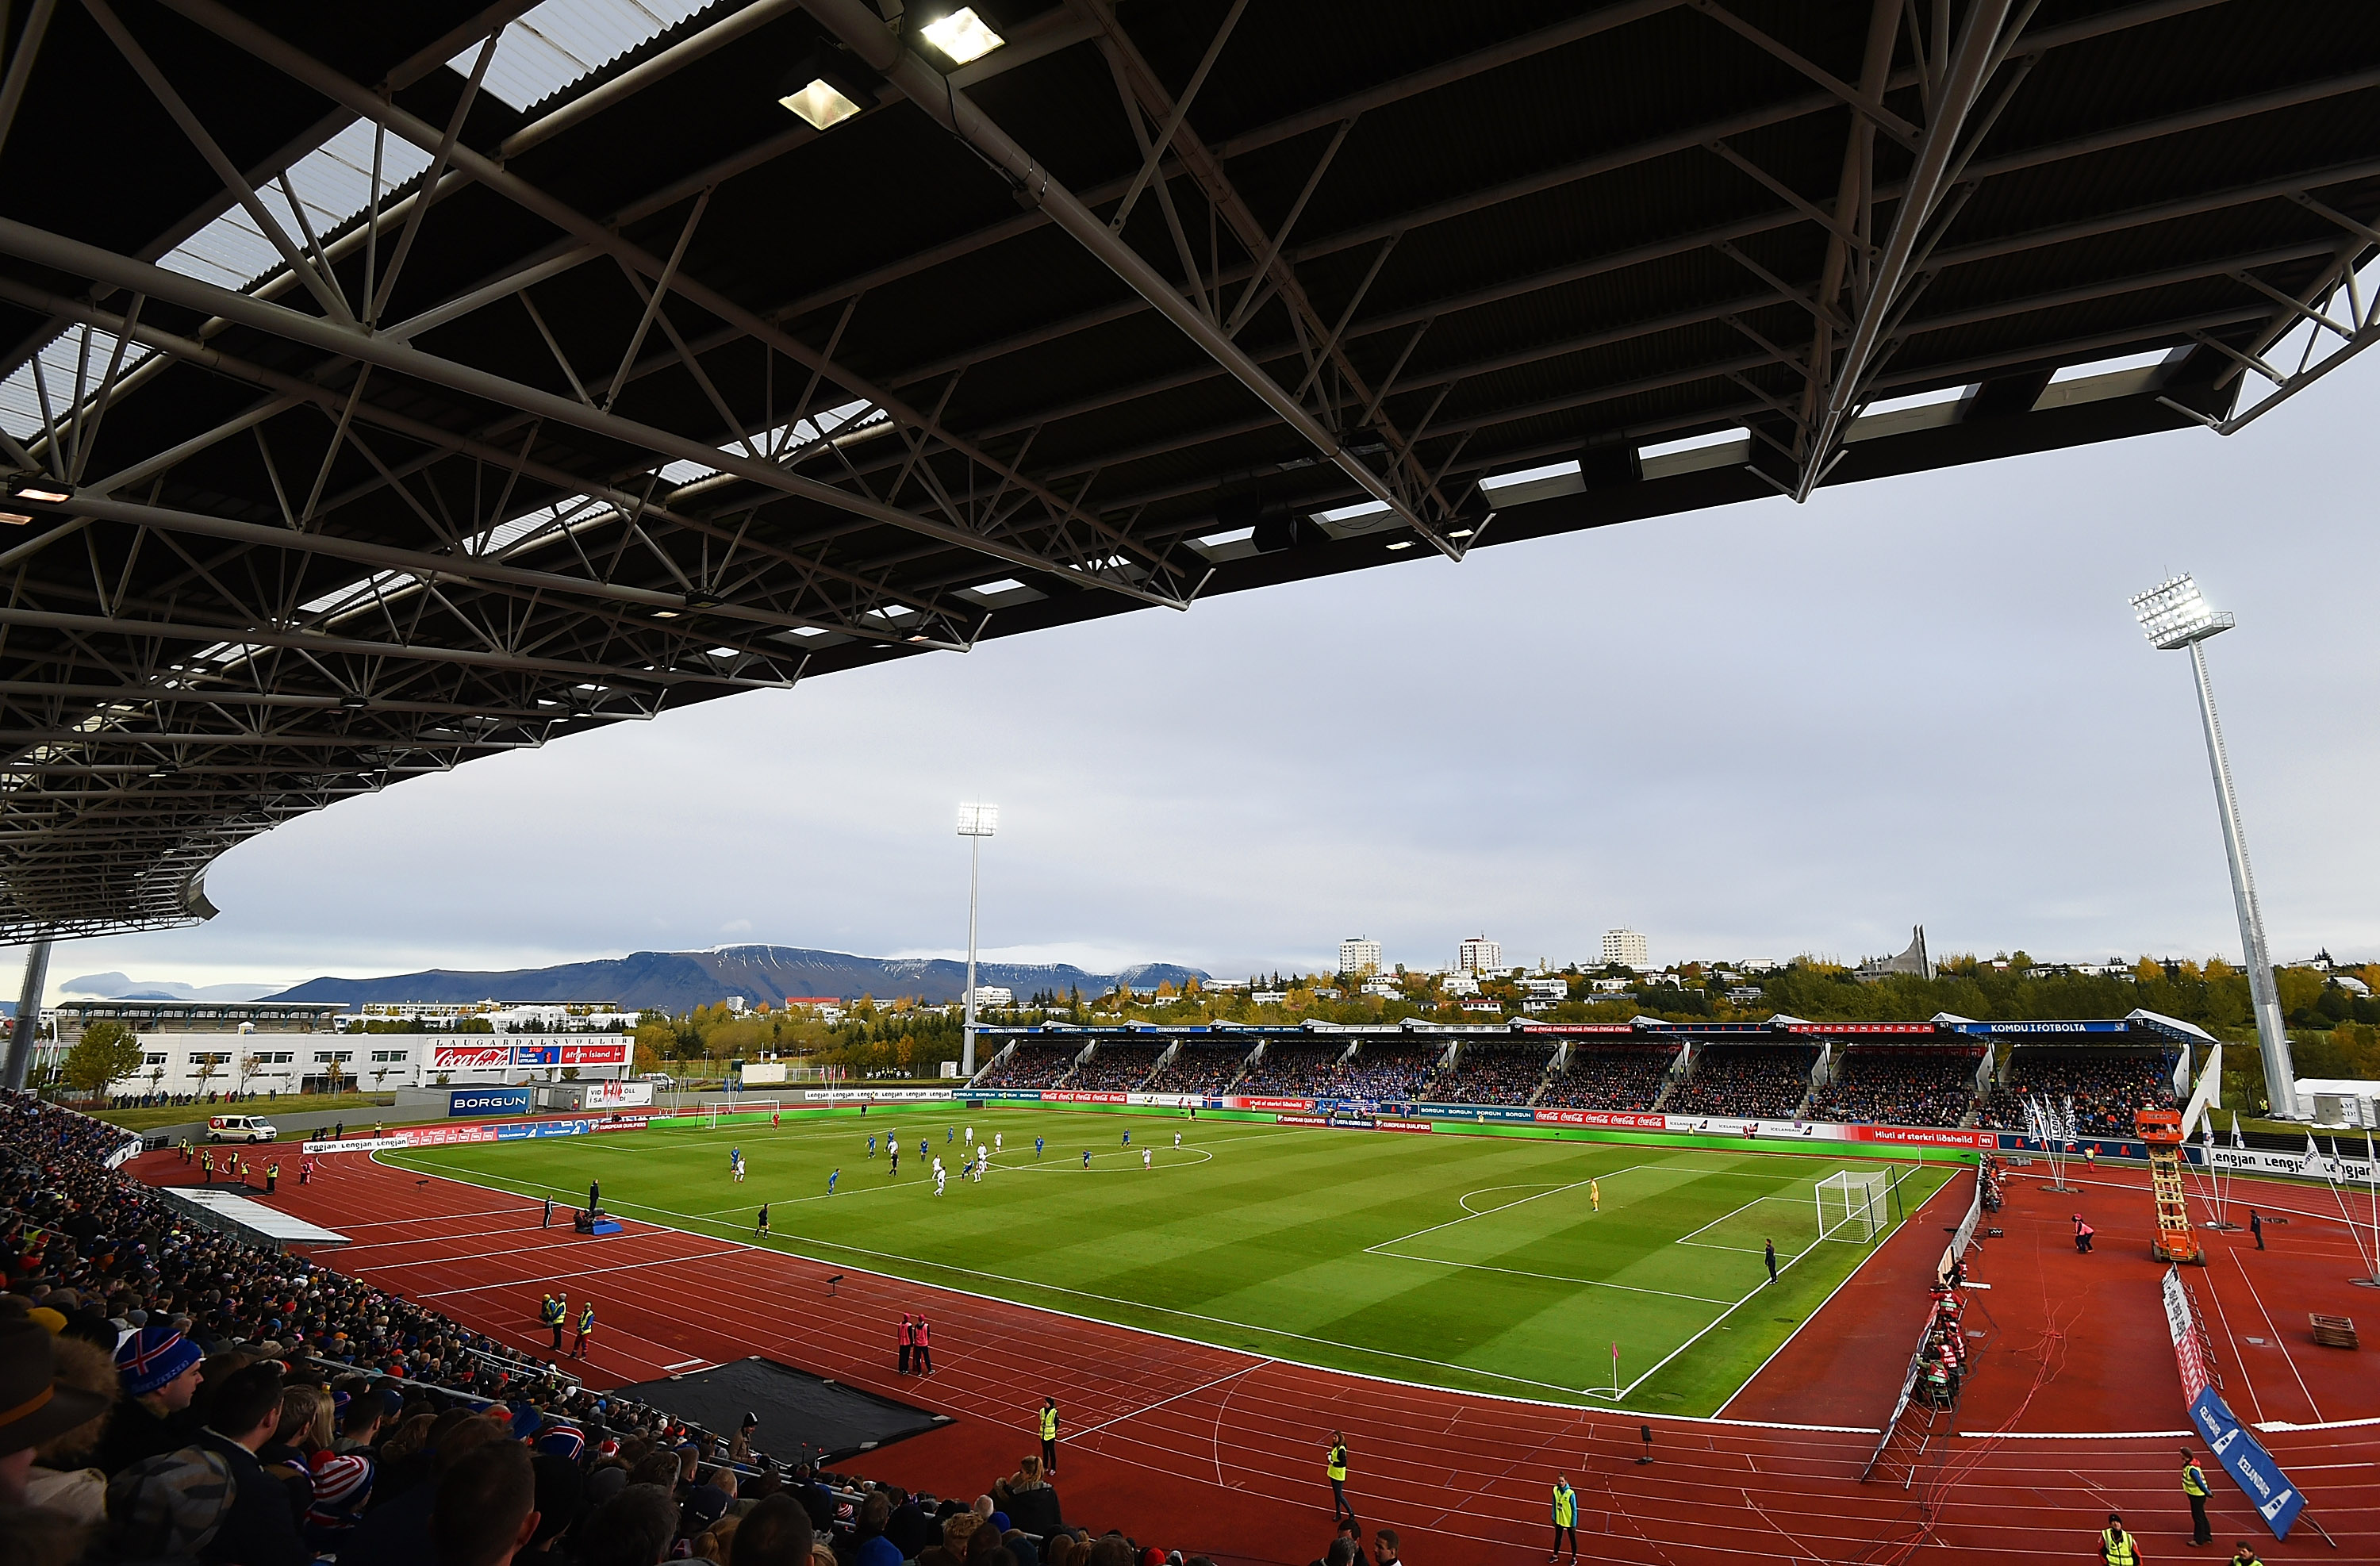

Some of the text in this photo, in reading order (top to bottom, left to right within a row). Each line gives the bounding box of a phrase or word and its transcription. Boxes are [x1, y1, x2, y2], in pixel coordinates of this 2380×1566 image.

[454, 1097, 526, 1108] BORGUN
[1536, 1111, 1558, 1121] Coca-Cola
[1561, 1113, 1583, 1122] Coca-Cola
[1586, 1114, 1609, 1123] Coca-Cola
[1611, 1115, 1635, 1125] Coca-Cola
[1638, 1116, 1662, 1126] Coca-Cola
[1875, 1130, 1895, 1139] Hluti
[1907, 1133, 1934, 1141] sterkri
[341, 1141, 372, 1149] Lengjan
[377, 1139, 406, 1147] Lengjan
[2213, 1153, 2256, 1167] engjan
[2265, 1158, 2304, 1172] Lengja
[2199, 1405, 2221, 1437] ICELANDAIR
[2238, 1455, 2270, 1499] ICELANDAIR
